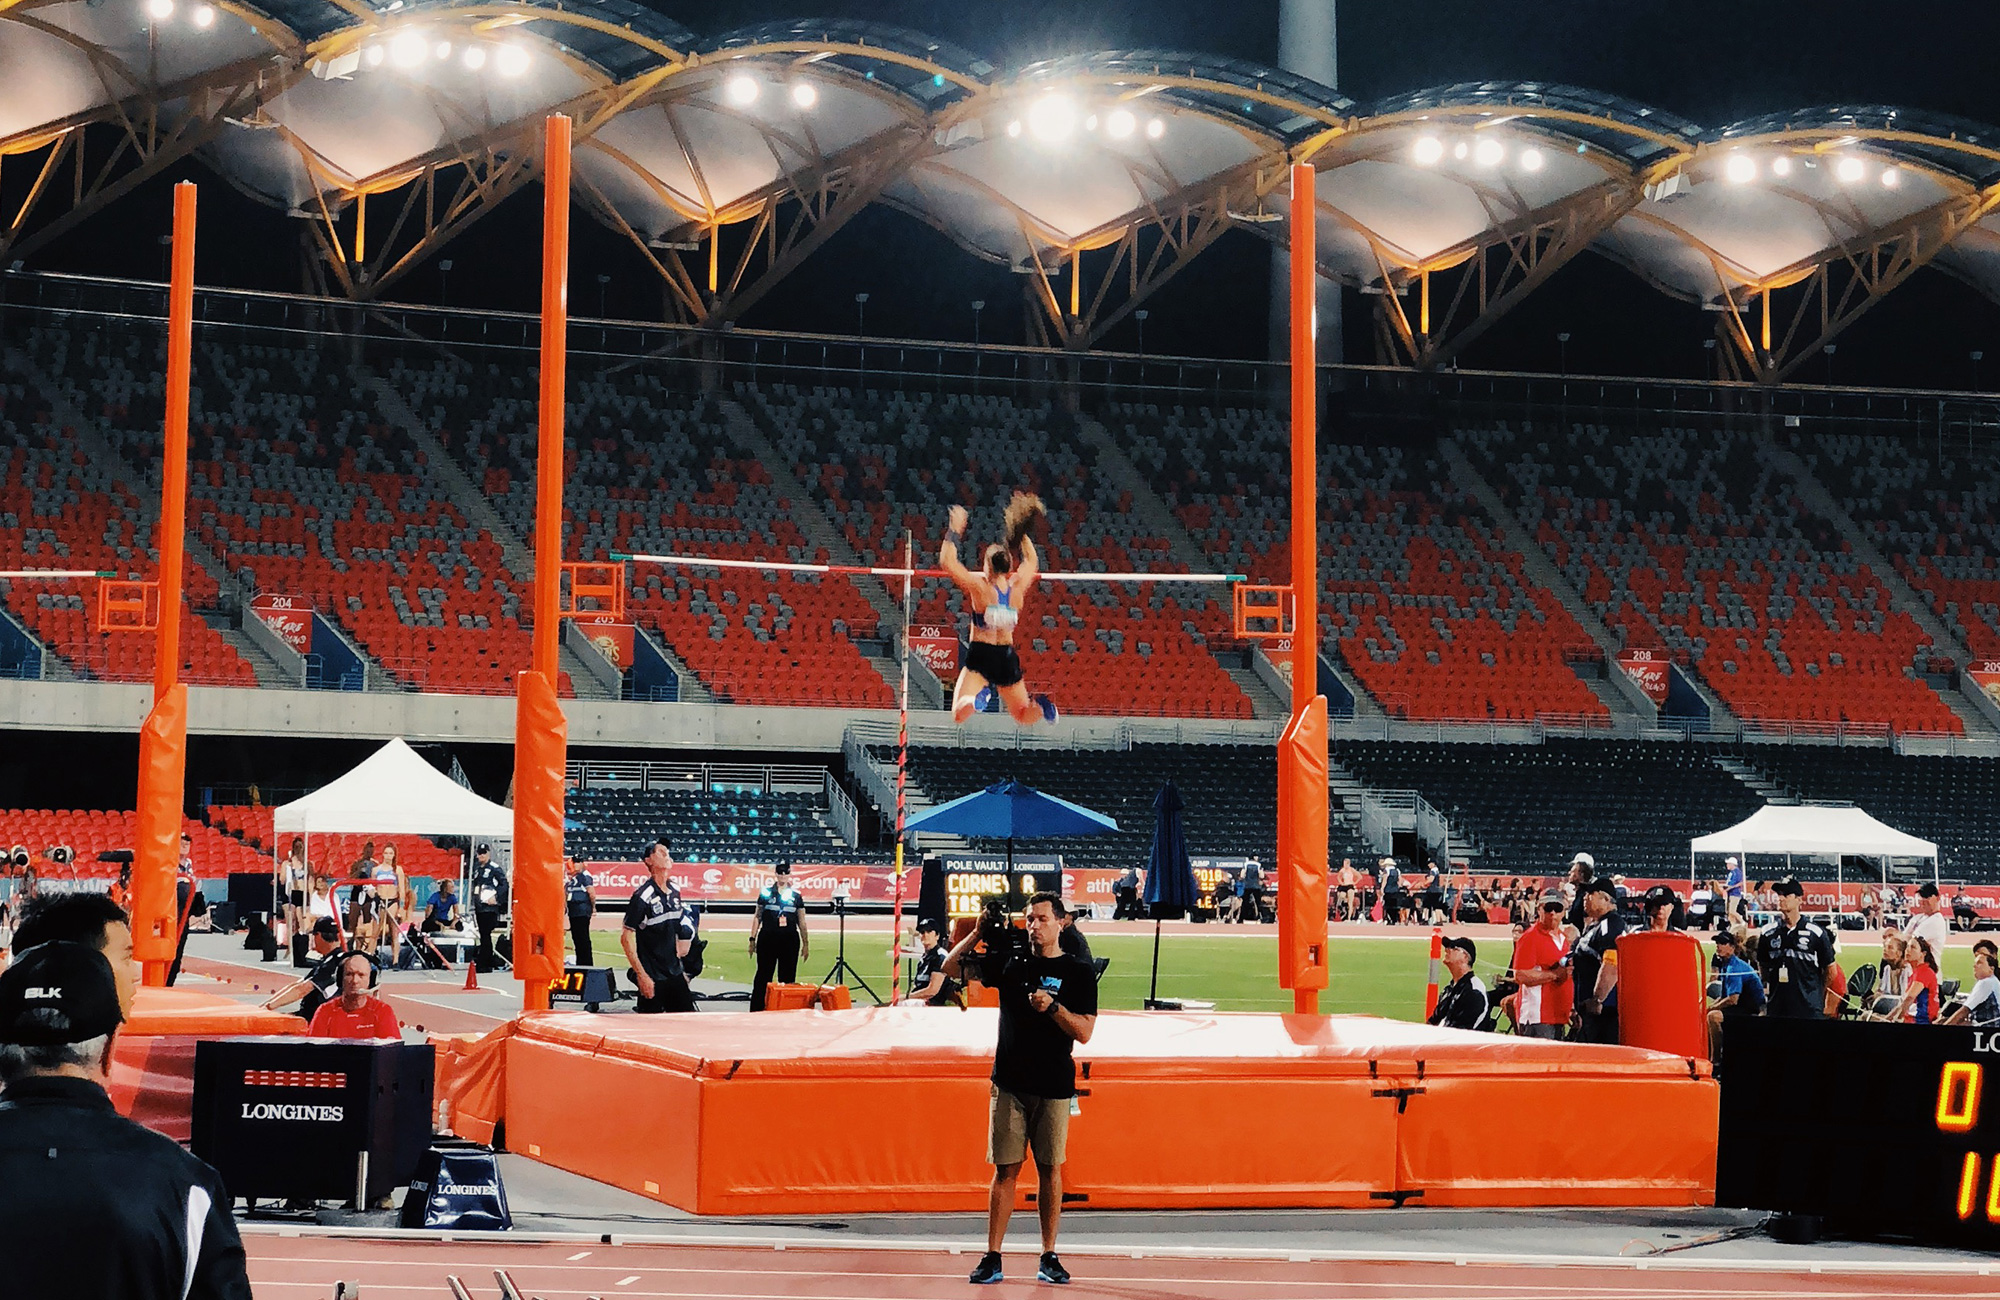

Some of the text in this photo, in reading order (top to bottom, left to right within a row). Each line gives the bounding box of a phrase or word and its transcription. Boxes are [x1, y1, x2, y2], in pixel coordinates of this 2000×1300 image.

[272, 597, 292, 608] 204
[920, 627, 941, 638] 206
[915, 644, 936, 656] WE
[1277, 639, 1291, 650] 20
[931, 649, 952, 660] ARE
[1633, 651, 1652, 661] 208
[1628, 666, 1648, 679] WE
[946, 861, 973, 871] POLE
[975, 861, 1005, 872] VAULT
[1022, 874, 1035, 894] R
[948, 895, 981, 912] TAS
[24, 987, 63, 999] BLK
[241, 1103, 344, 1122] LONGINES
[438, 1184, 498, 1196] LONGINES
